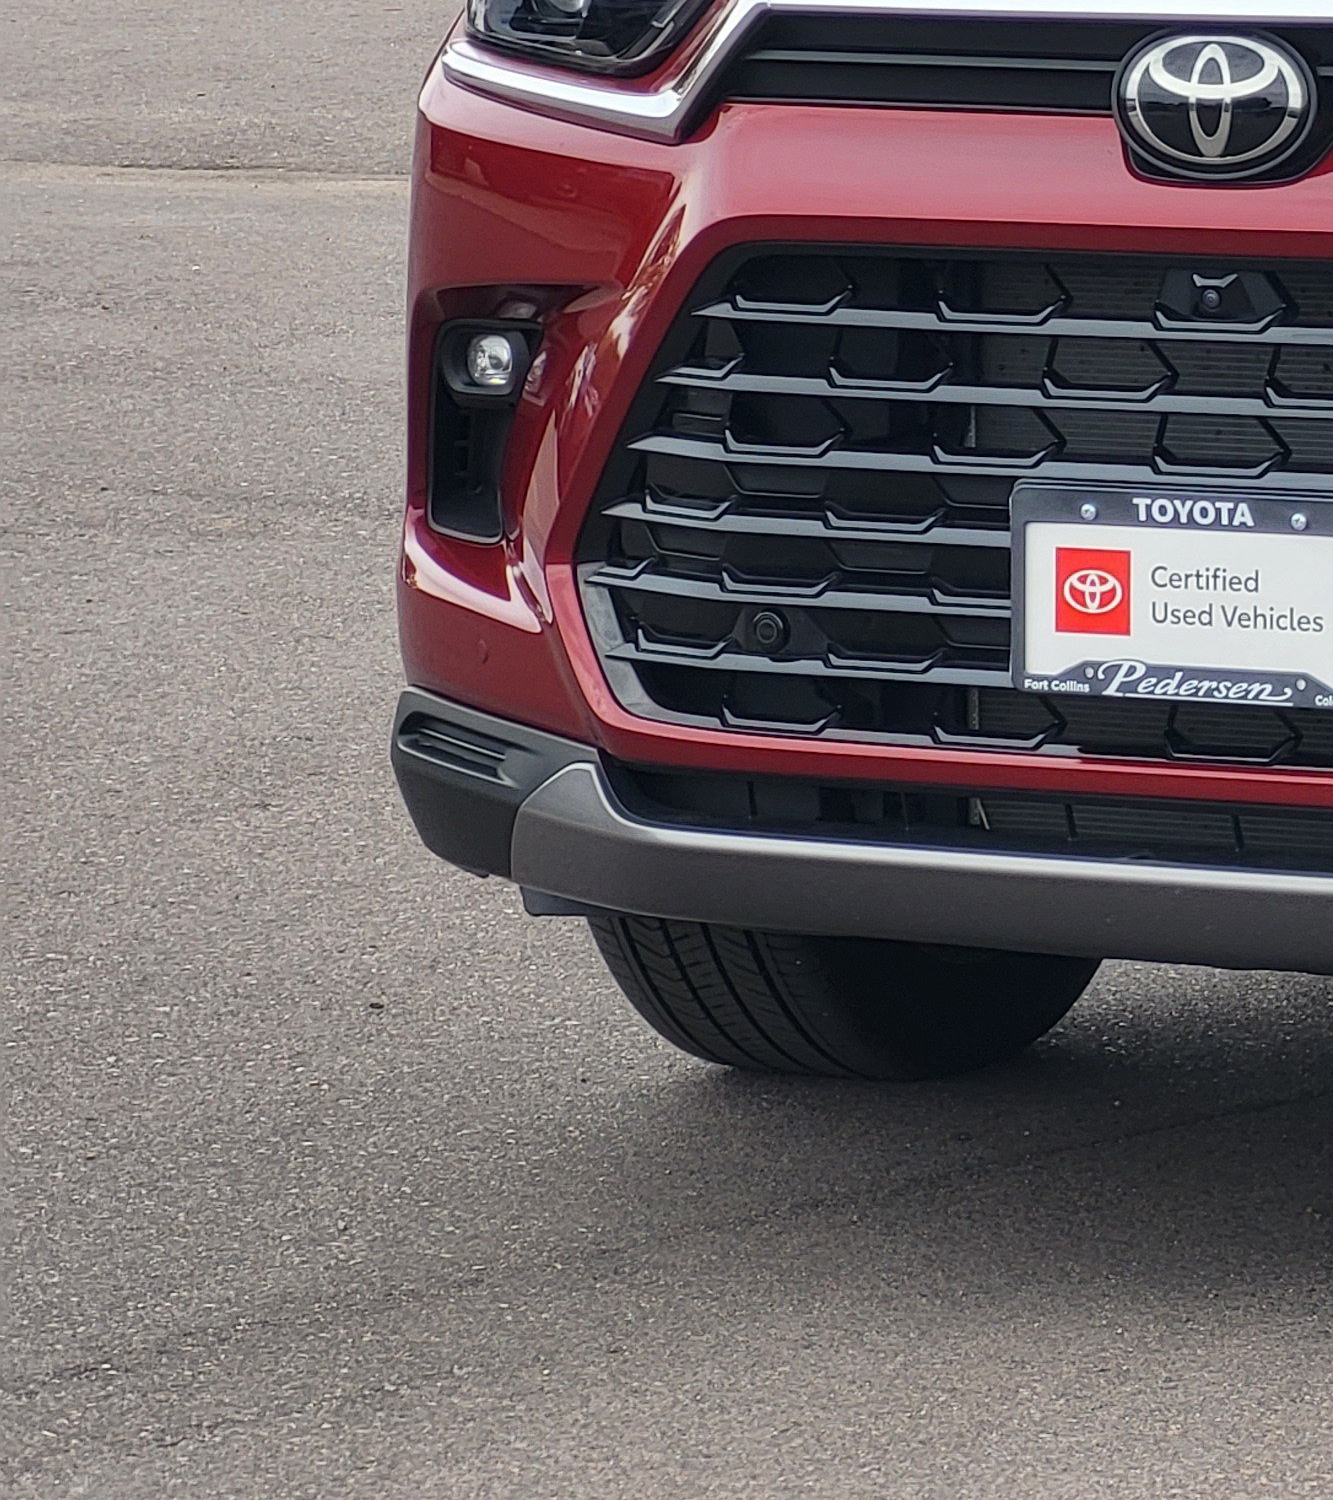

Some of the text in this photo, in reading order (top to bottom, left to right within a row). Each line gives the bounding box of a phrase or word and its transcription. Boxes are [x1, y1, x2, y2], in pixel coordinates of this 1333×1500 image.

[1132, 498, 1255, 527] TOYOTA
[1150, 565, 1260, 593] Certified
[1151, 601, 1325, 633] Used Vehicles
[1024, 678, 1090, 693] Fort Collins
[1098, 660, 1293, 702] Pedersen
